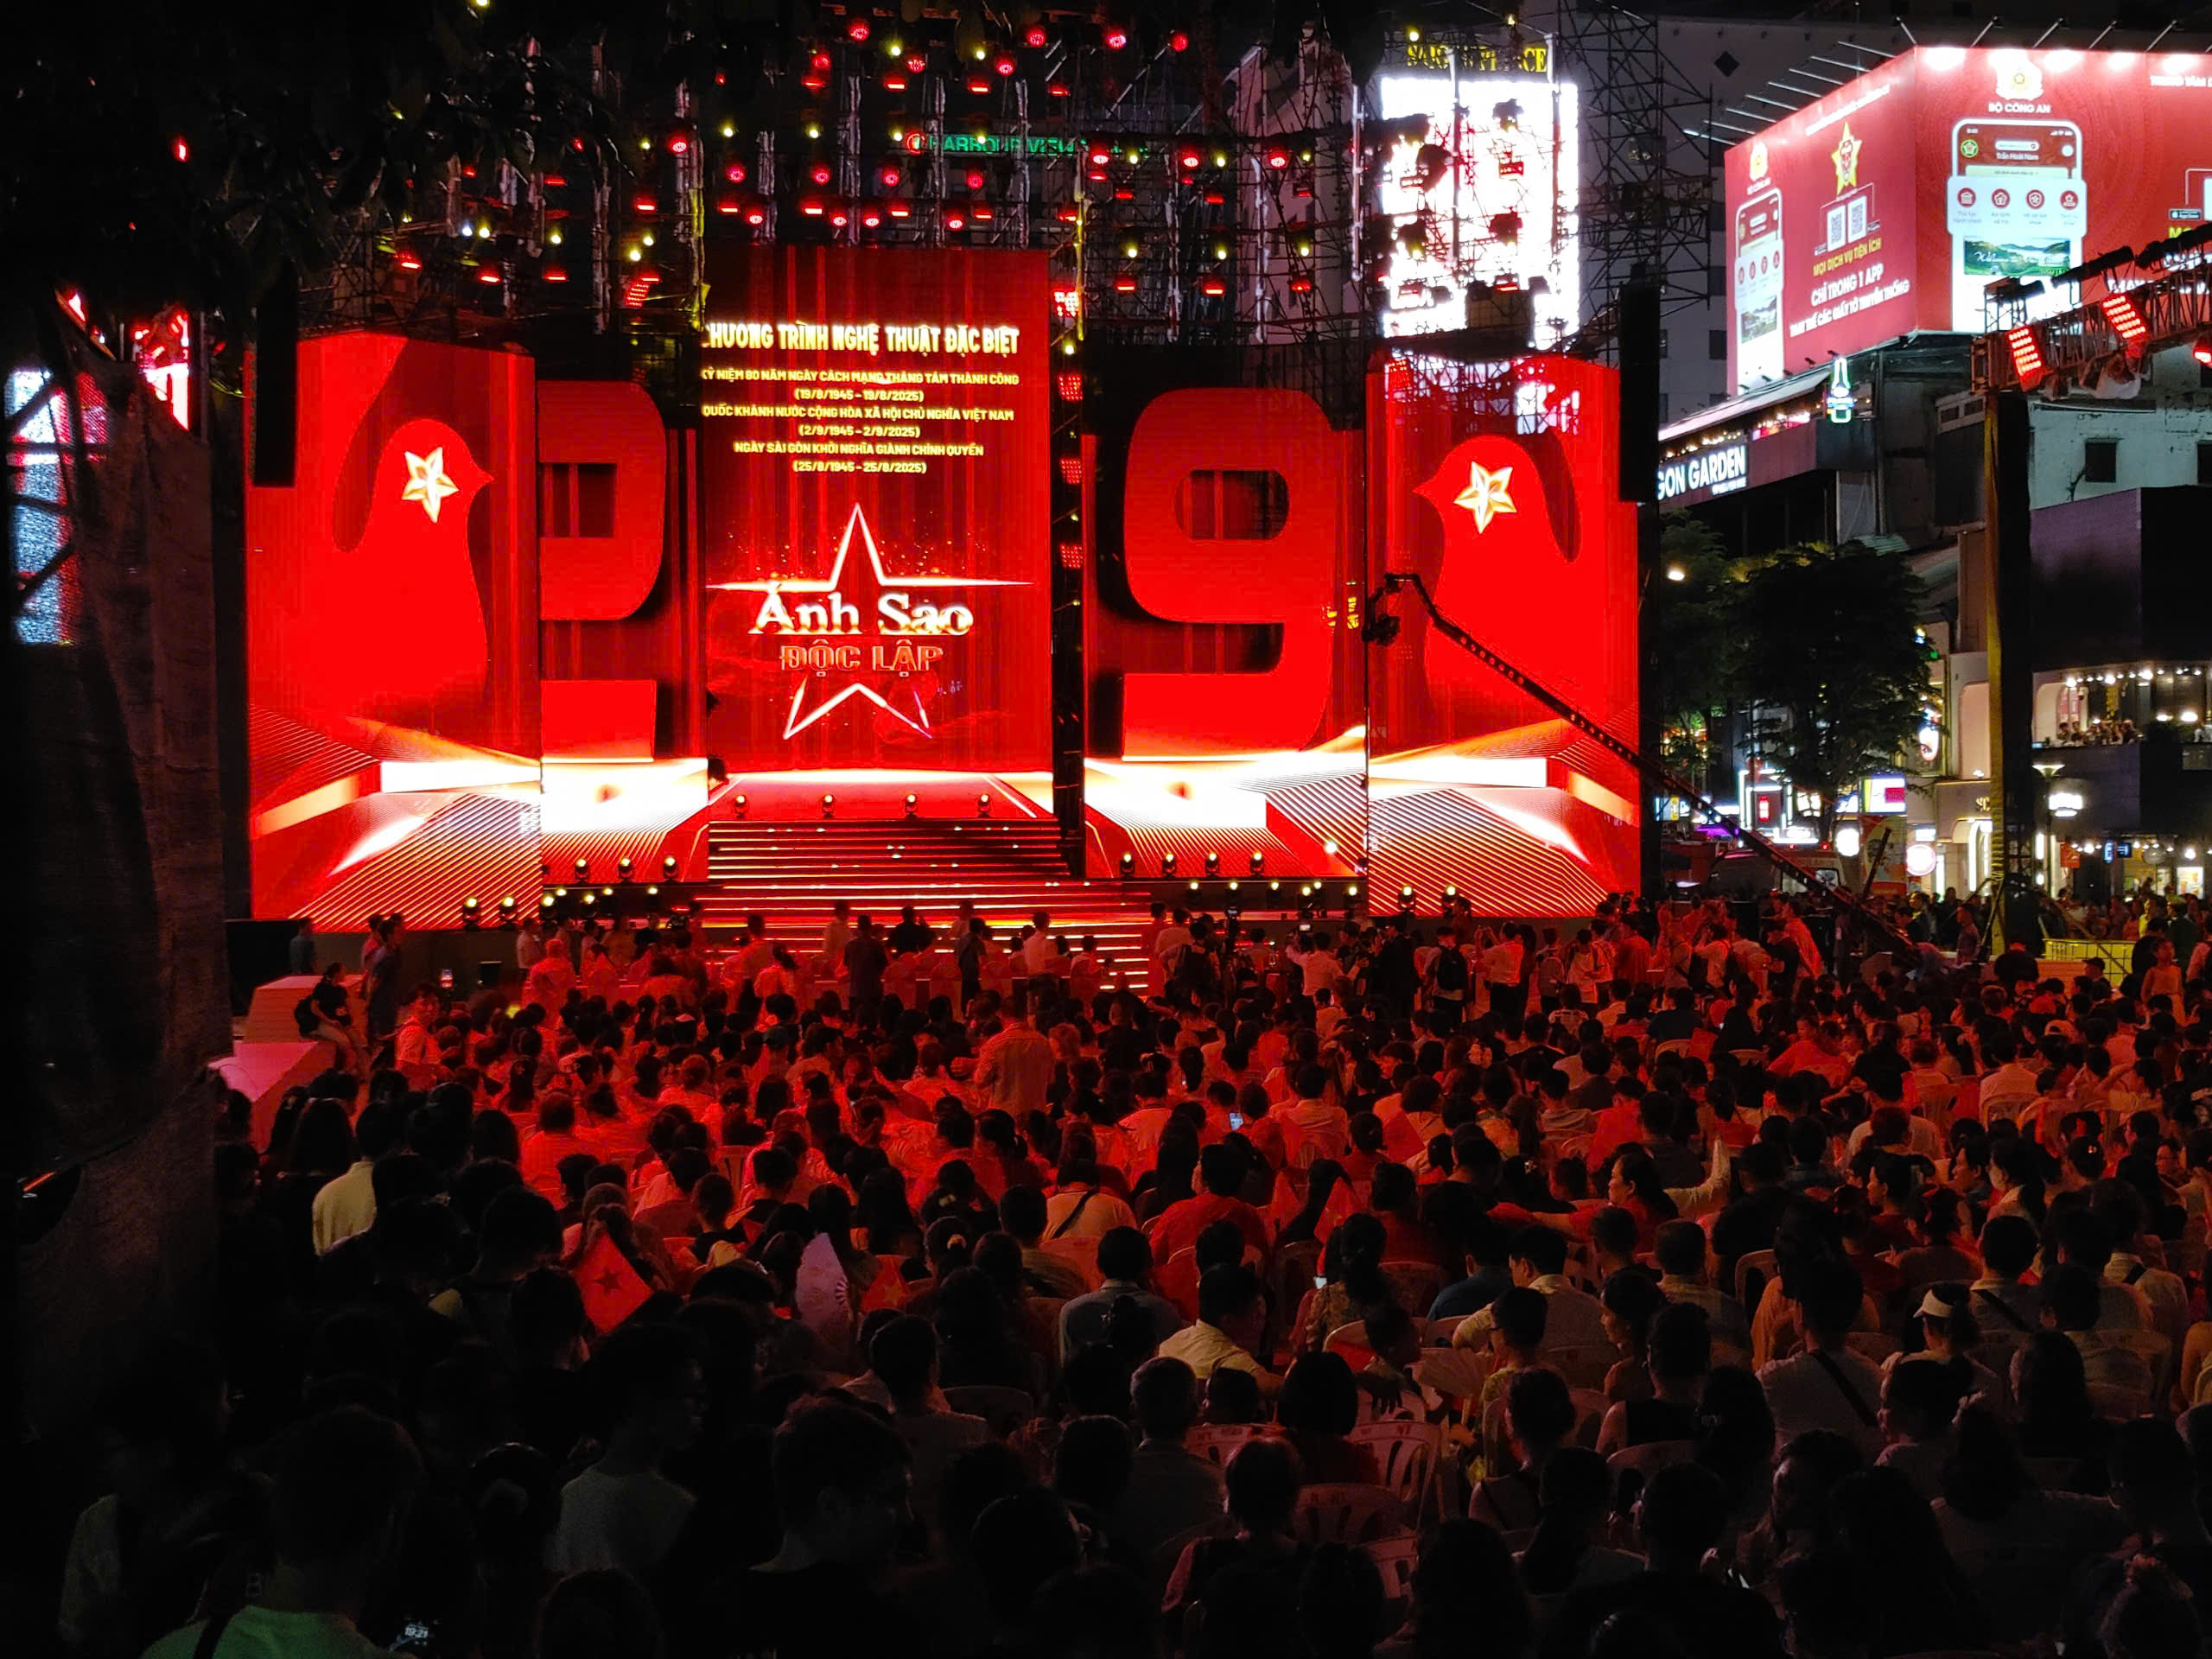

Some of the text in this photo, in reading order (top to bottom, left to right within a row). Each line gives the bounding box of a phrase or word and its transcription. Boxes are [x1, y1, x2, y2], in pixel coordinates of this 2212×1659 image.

[2005, 101, 2035, 114] CÔNG
[2036, 103, 2051, 114] AN
[1827, 273, 1858, 300] TRONG
[1858, 270, 1864, 288] 1
[1866, 263, 1884, 285] APP
[777, 320, 830, 351] TRÌNH
[832, 323, 880, 356] NGHỆ
[884, 324, 942, 357] THUẬT
[944, 324, 981, 358] ĐẶC
[982, 325, 1020, 358] BIỆT
[716, 367, 744, 382] NIỆM
[745, 369, 760, 381] 80
[761, 368, 786, 381] NĂM
[788, 369, 817, 381] NGÀY
[819, 370, 849, 382] CÁCH
[925, 370, 949, 385] TÁM
[950, 371, 988, 385] THÀNH
[988, 371, 1020, 385] CÔNG
[794, 388, 854, 401] (19/8/1945
[863, 390, 925, 403] 19/8/2025)
[702, 402, 734, 416] QUỐC
[734, 403, 774, 416] KHÁNH
[808, 405, 838, 420] CỘNG
[839, 405, 862, 418] HÒA
[864, 405, 880, 419] XÃ
[882, 406, 901, 421] HỘI
[902, 405, 925, 420] CHỦ
[926, 407, 961, 421] NGHĨA
[962, 408, 988, 422] VIỆT
[988, 410, 1014, 421] NAM
[798, 424, 854, 436] (2/9/1945
[863, 426, 921, 438] 2/9/2025)
[734, 441, 766, 454] NGÀY
[766, 441, 786, 454] SÀI
[787, 442, 811, 454] GÒN
[839, 442, 874, 454] NGHĨA
[875, 443, 910, 455] GIÀNH
[912, 443, 945, 456] CHÍNH
[792, 461, 855, 472] (25/8/1945
[863, 461, 927, 474] 25/8/2025)
[1688, 445, 1746, 491] GARDEN
[1123, 387, 1336, 762] 9
[878, 592, 974, 635] Sao
[780, 639, 944, 677] ĐỘC LẬP
